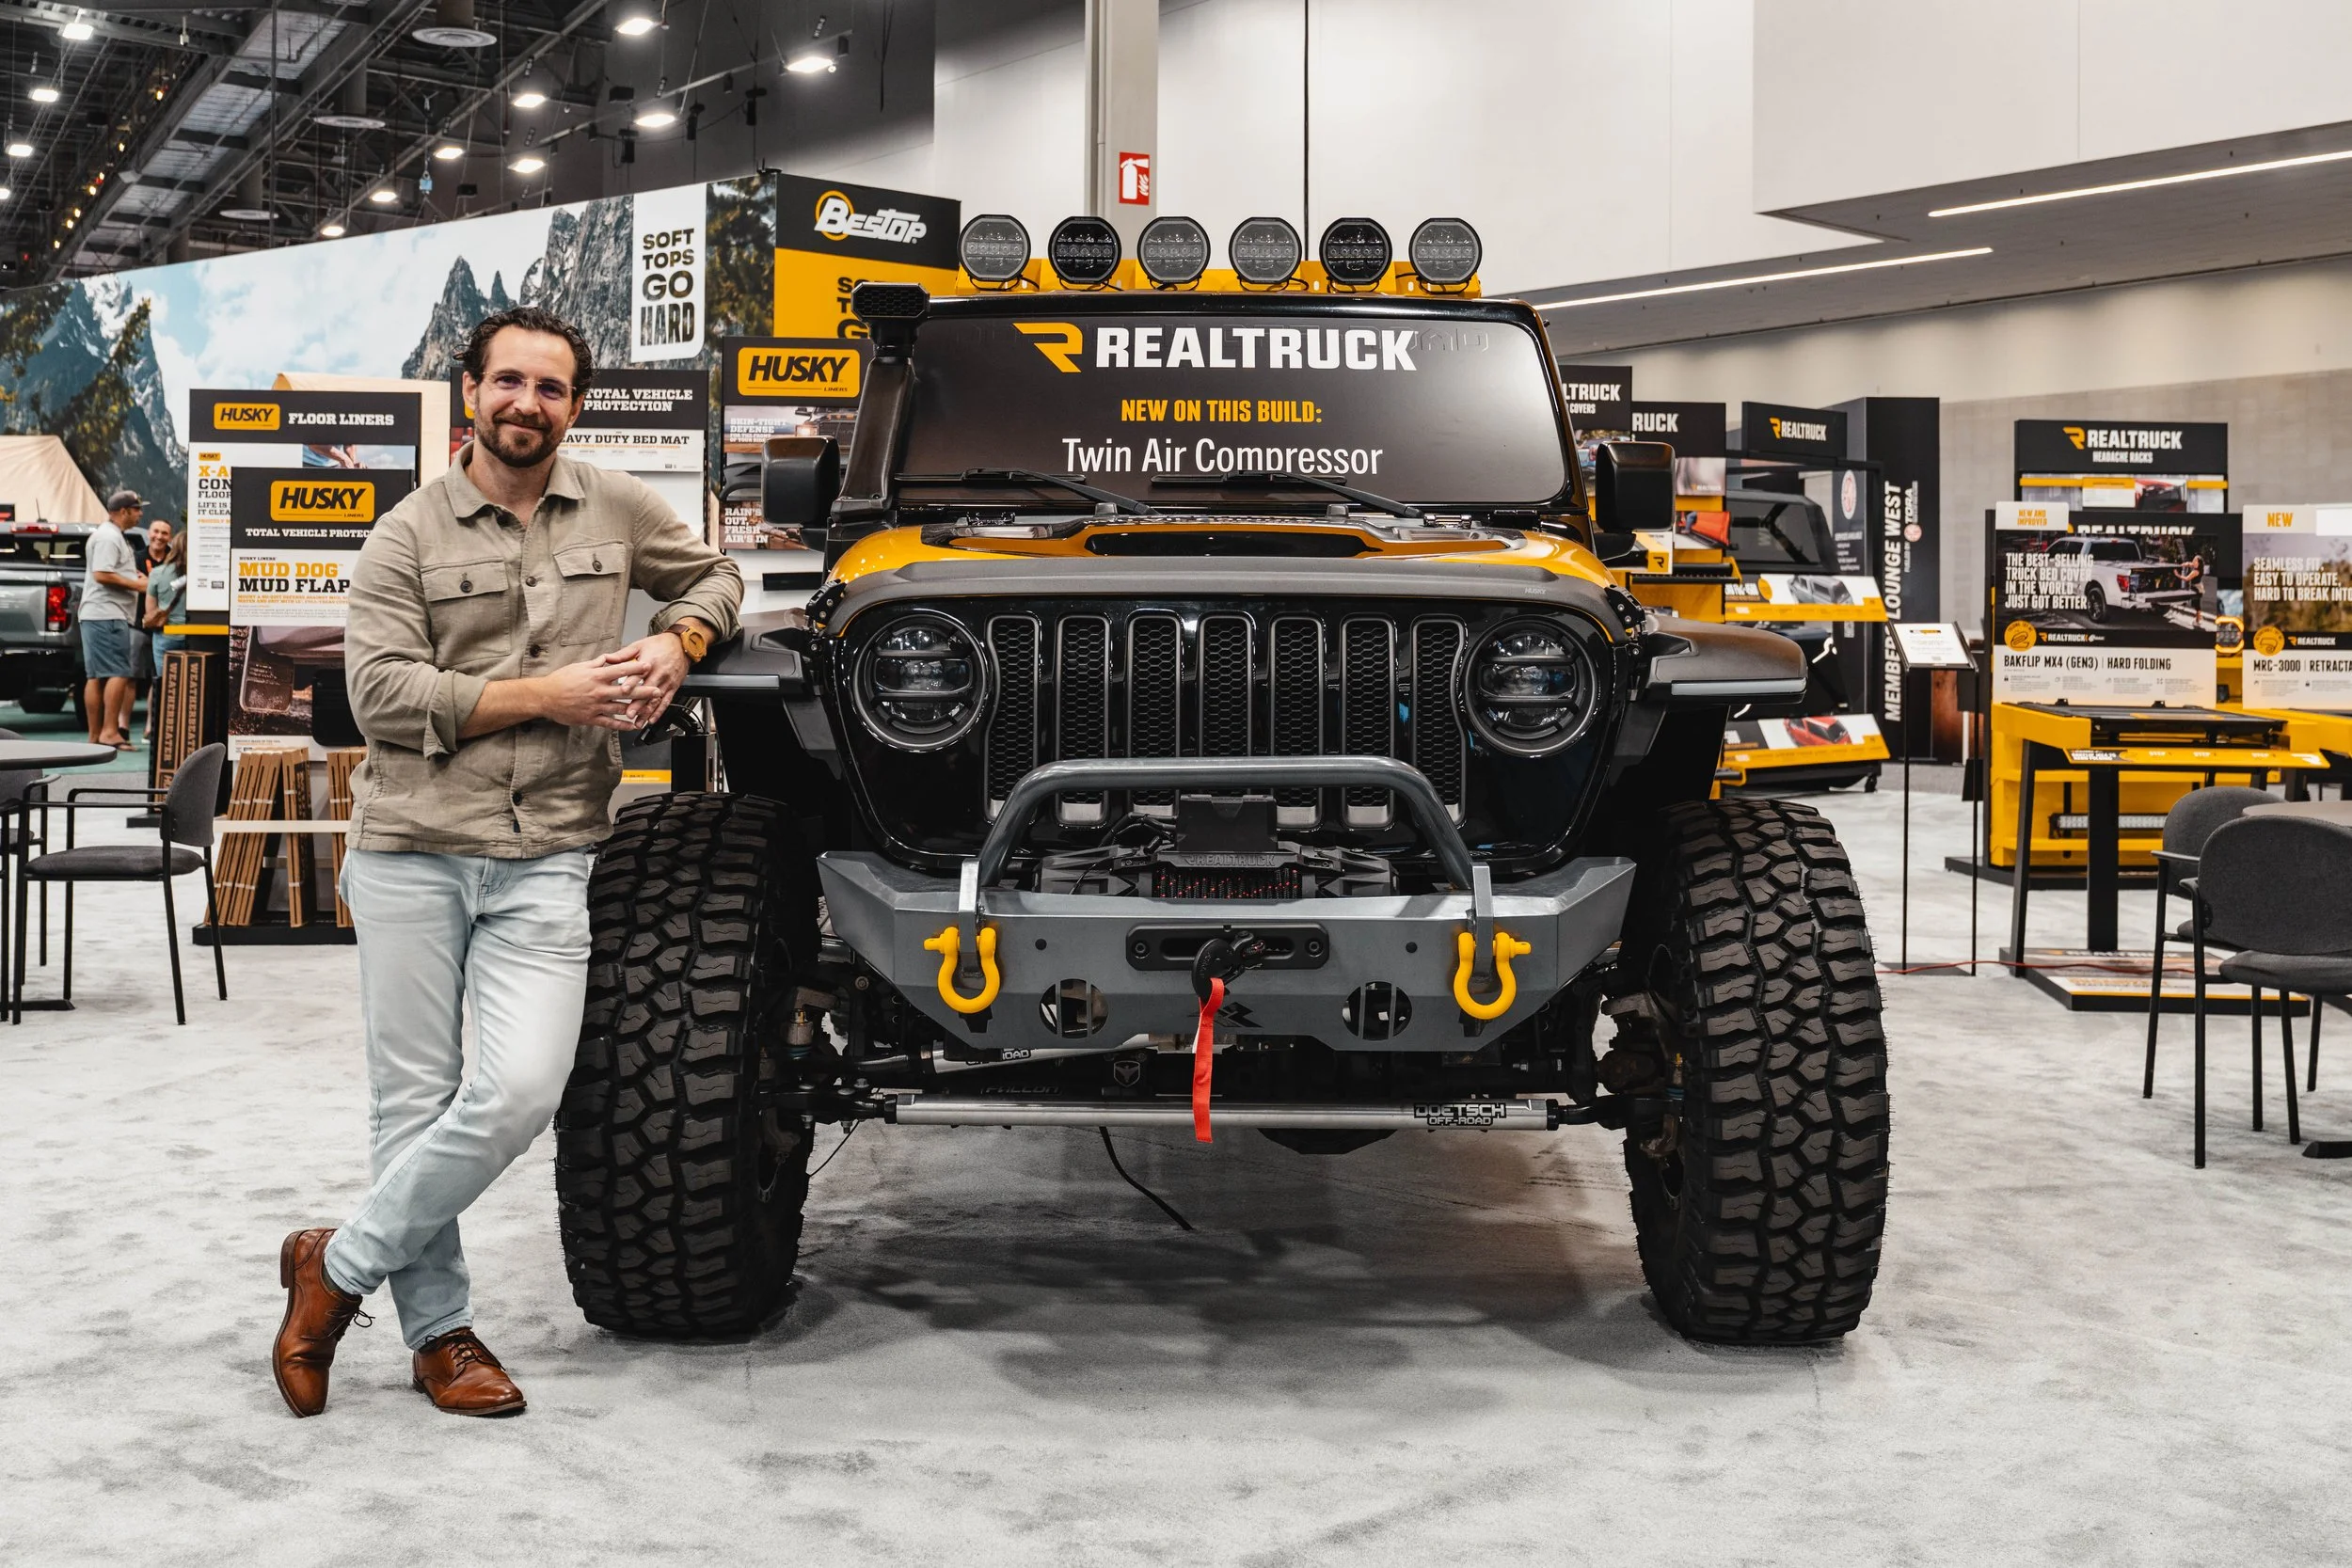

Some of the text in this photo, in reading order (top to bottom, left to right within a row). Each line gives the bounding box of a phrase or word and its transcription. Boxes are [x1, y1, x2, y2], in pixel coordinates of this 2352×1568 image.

[643, 228, 694, 250] SOFT
[643, 249, 694, 270] TOPS
[643, 270, 693, 301] GO
[641, 302, 694, 346] HARD
[1096, 327, 1418, 371] REALTRUCK
[749, 356, 850, 382] HUSKY
[585, 388, 693, 401] TOTAL VEHICLE
[583, 400, 674, 412] PROTECTION
[1120, 399, 1322, 423] NEW ON THIS BUILD:
[1570, 403, 1596, 414] COVERS
[220, 407, 394, 425] HUSKY FLOOR LINERS
[730, 425, 775, 434] DEFENSE
[1781, 420, 1827, 441] REALTRUCK
[562, 435, 690, 445] AVY DUTY BED MAT
[2087, 429, 2183, 450] REALTRUCK
[1062, 437, 1383, 475] Twin Air Compressor
[2092, 451, 2153, 464] HEADACHE RACKS
[199, 465, 229, 477] X-A
[279, 487, 367, 510] HUSKY
[1904, 487, 1913, 524] TORA
[725, 508, 762, 516] RAIN'S
[1884, 481, 1900, 536] WEST
[2018, 509, 2033, 517] NEW
[724, 516, 749, 527] OUT,
[2017, 517, 2047, 526] IMPROVED
[2266, 512, 2294, 527] NEW
[246, 528, 280, 537] TOTAL
[282, 529, 327, 538] VEHICLE
[724, 526, 760, 534] FRESH
[724, 534, 768, 544] AIR'S IN
[2006, 552, 2094, 568] THE BEST-SELLING
[2253, 556, 2325, 571] SEAMLESS FIT.
[238, 562, 291, 577] MUD
[295, 562, 339, 578] DOG
[2005, 567, 2091, 581] TRUCK BED COVER
[238, 578, 290, 593] MUD
[295, 578, 350, 593] FLAP
[1884, 540, 1900, 620] LOUNGE
[2253, 572, 2279, 586] EASY
[2280, 572, 2294, 586] TO
[2005, 580, 2074, 595] IN THE WORLD
[2253, 587, 2280, 601] HARD
[2282, 587, 2295, 601] TO
[2296, 587, 2329, 601] BREAK
[2005, 595, 2029, 609] JUST
[2032, 595, 2050, 609] GOT
[2047, 633, 2086, 641] REALTRUCK
[2297, 637, 2336, 646] REALTRUCK
[2004, 655, 2171, 671] BAKFLIP MX4 (GEN3) HARD FOLDING
[2253, 659, 2301, 672] MRC-3000
[164, 662, 178, 761] WEATHERBEATER
[1197, 854, 1275, 866] REALTRUCK
[986, 1085, 1059, 1094] FALCON
[1415, 1103, 1505, 1117] DOETSCH
[1429, 1117, 1491, 1125] OFF-ROAD
